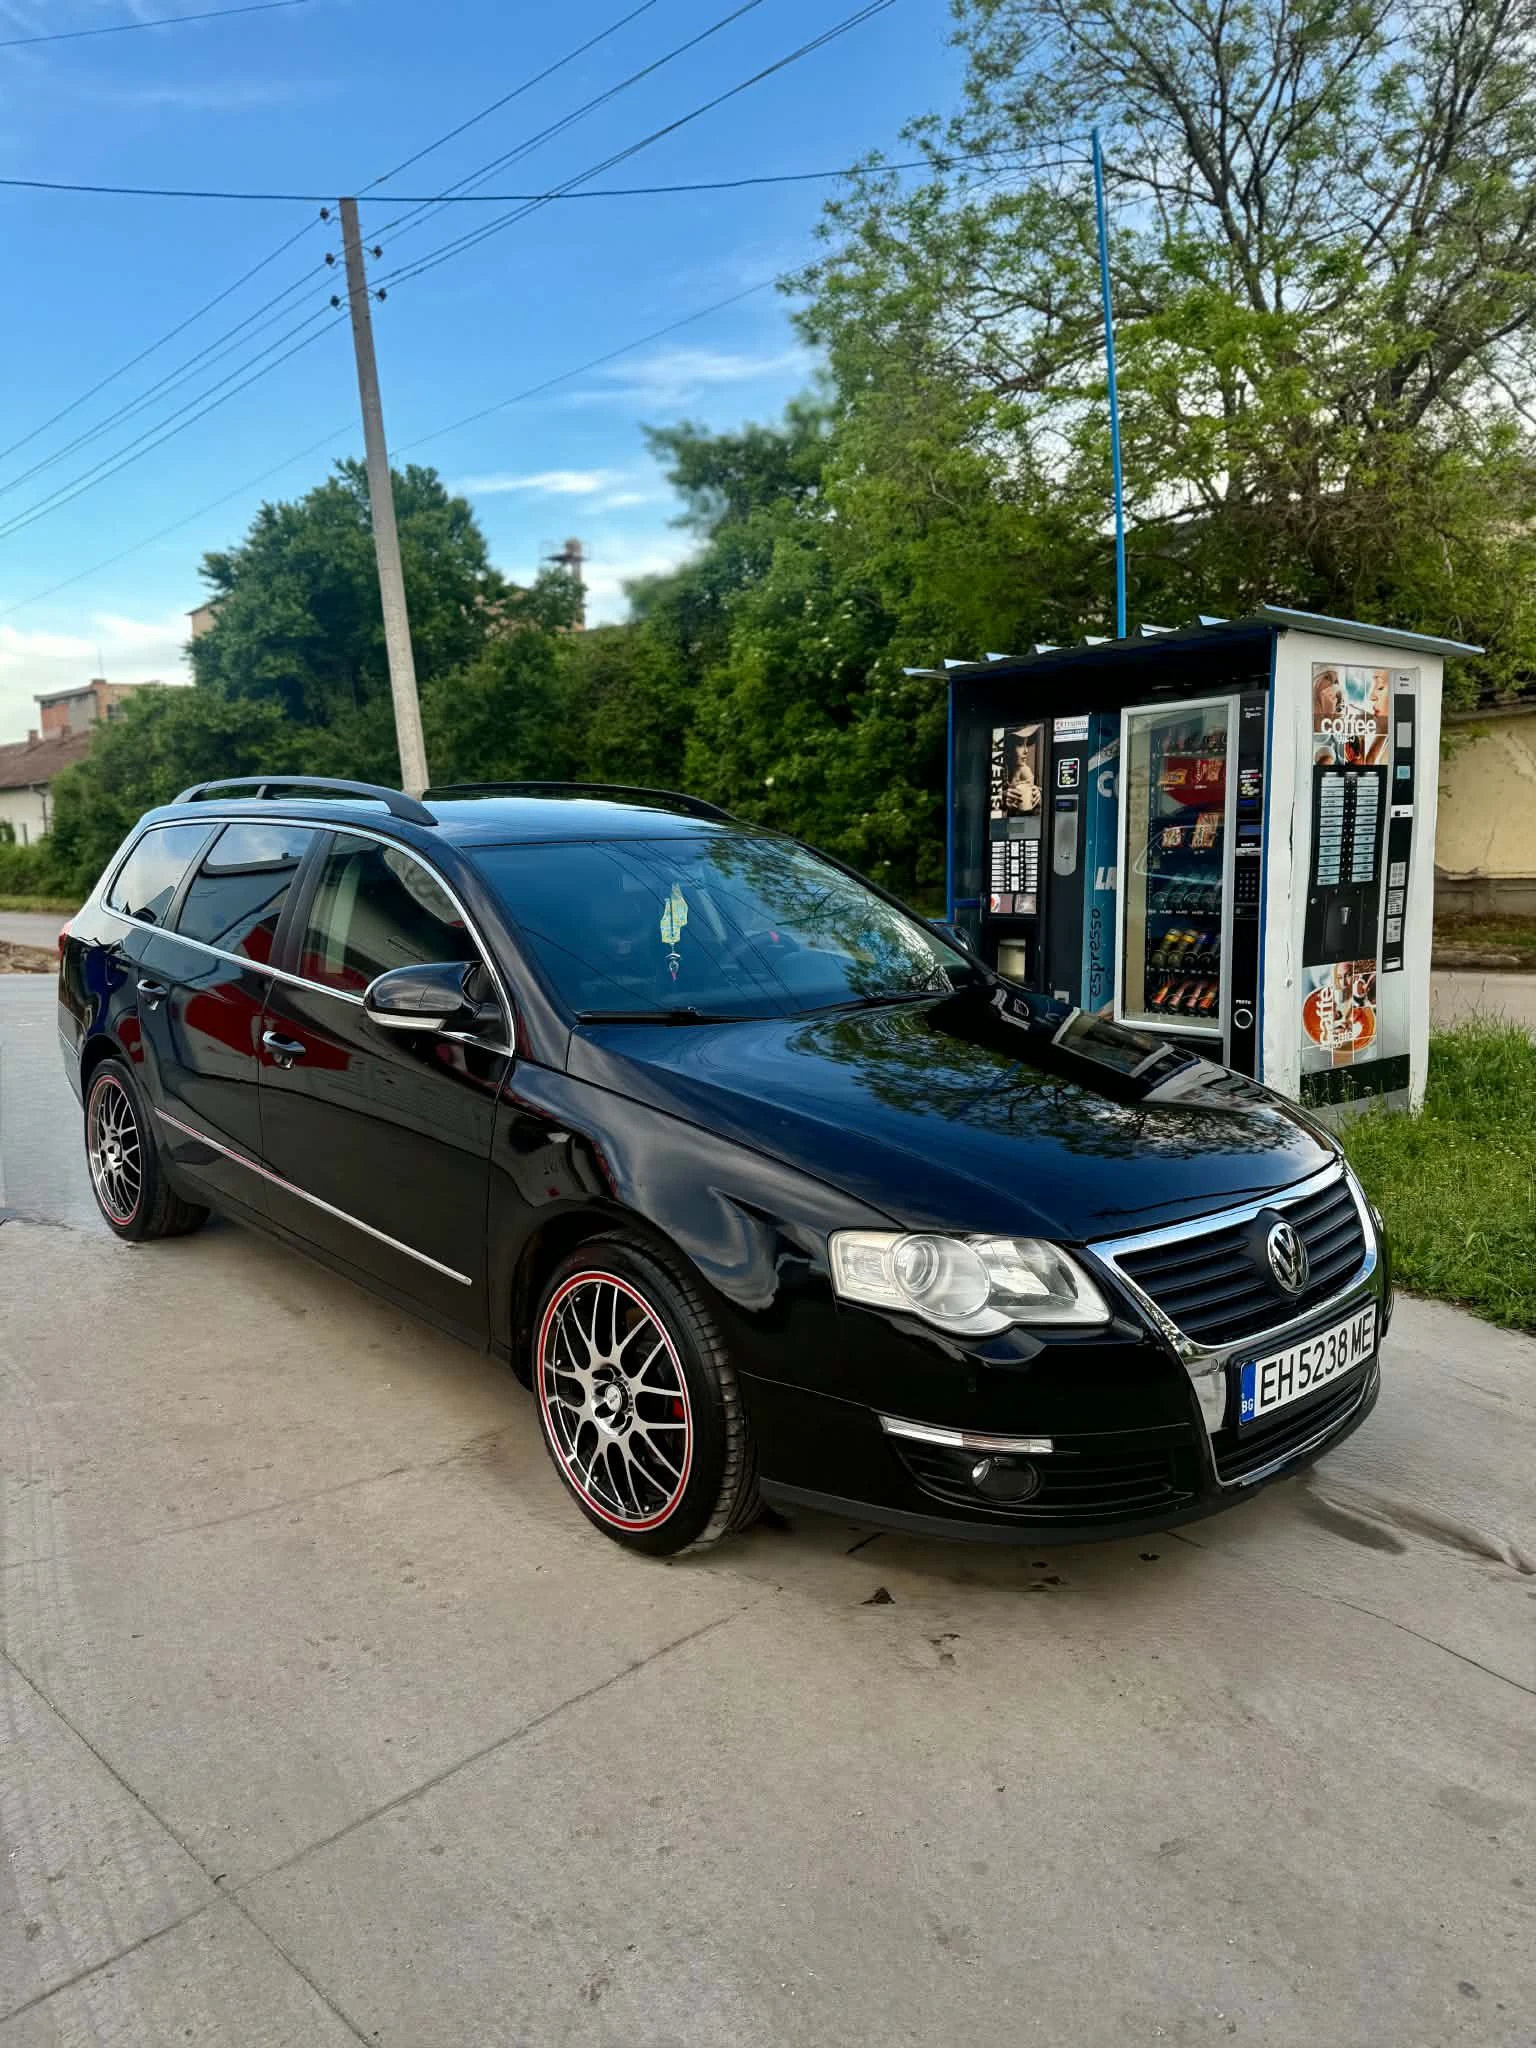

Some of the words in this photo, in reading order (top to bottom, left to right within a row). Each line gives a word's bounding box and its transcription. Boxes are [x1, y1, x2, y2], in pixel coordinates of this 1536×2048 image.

[1321, 713, 1376, 734] coffee
[1090, 908, 1105, 998] espresso
[1241, 1398, 1254, 1414] BG
